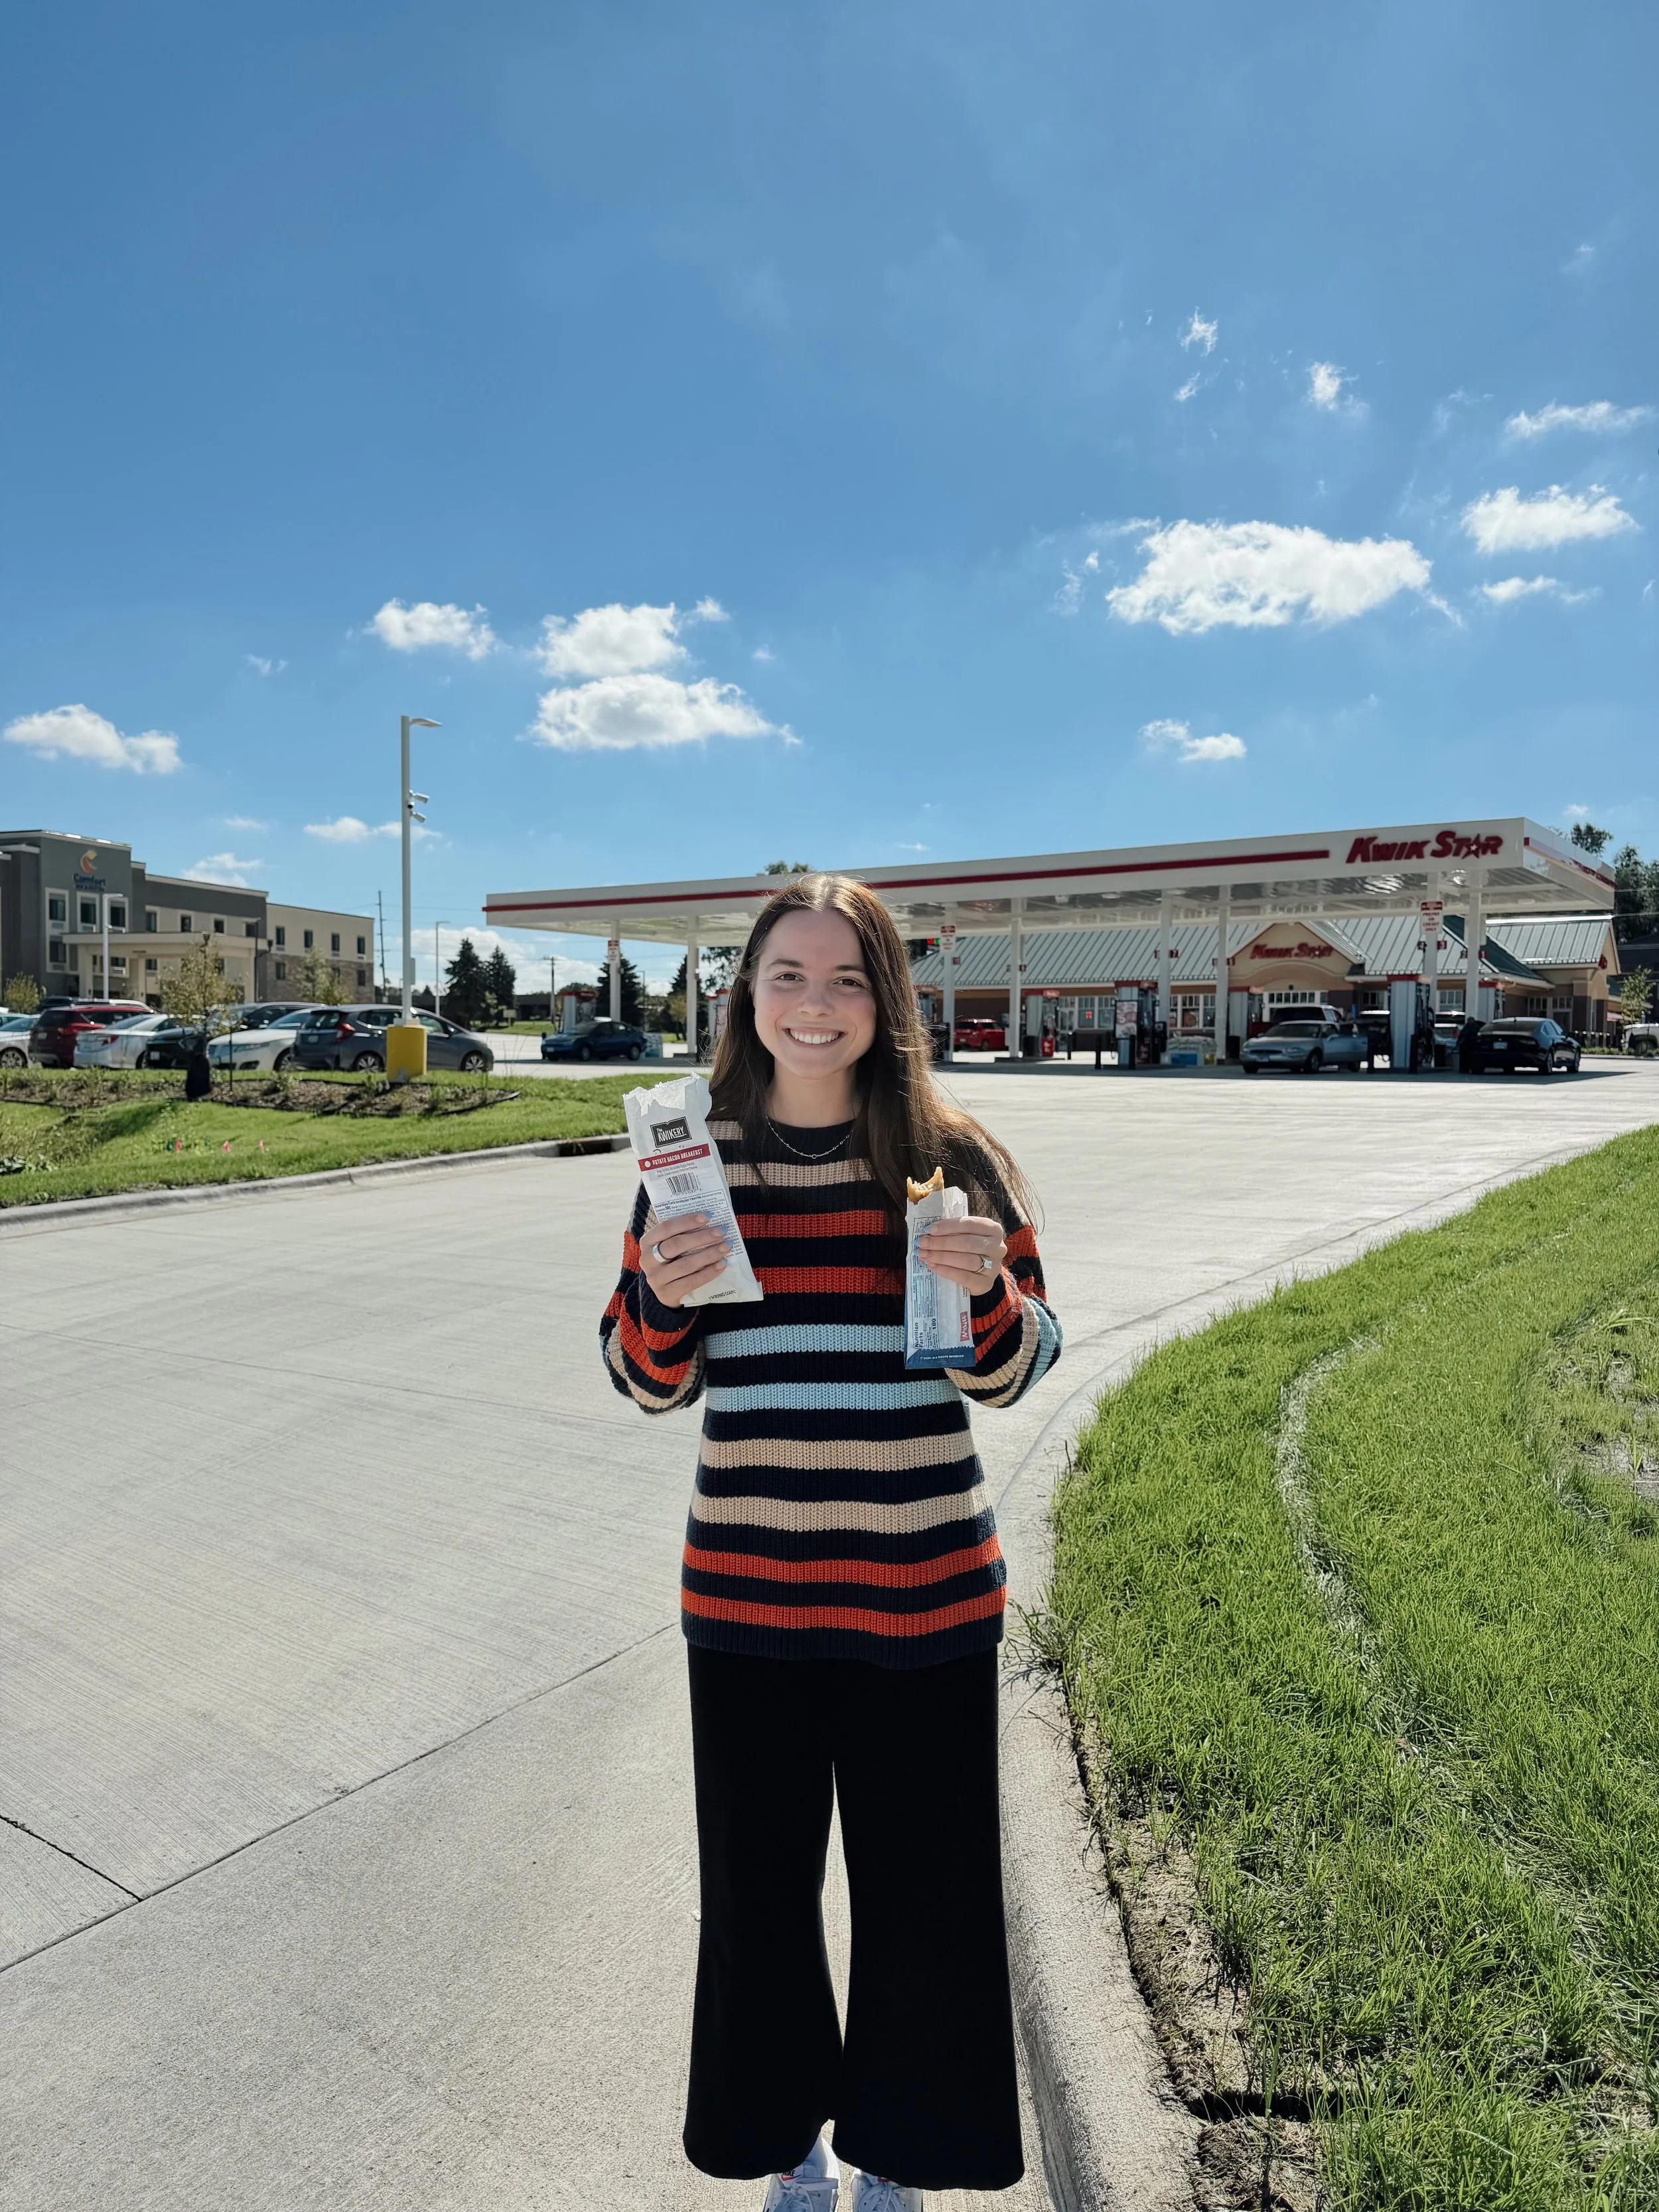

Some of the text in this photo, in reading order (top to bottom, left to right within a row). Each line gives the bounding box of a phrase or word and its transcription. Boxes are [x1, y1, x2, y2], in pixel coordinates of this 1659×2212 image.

[74, 873, 106, 887] Comfort
[658, 1126, 685, 1142] KWIKERY
[681, 1149, 703, 1160] BREAKFAST
